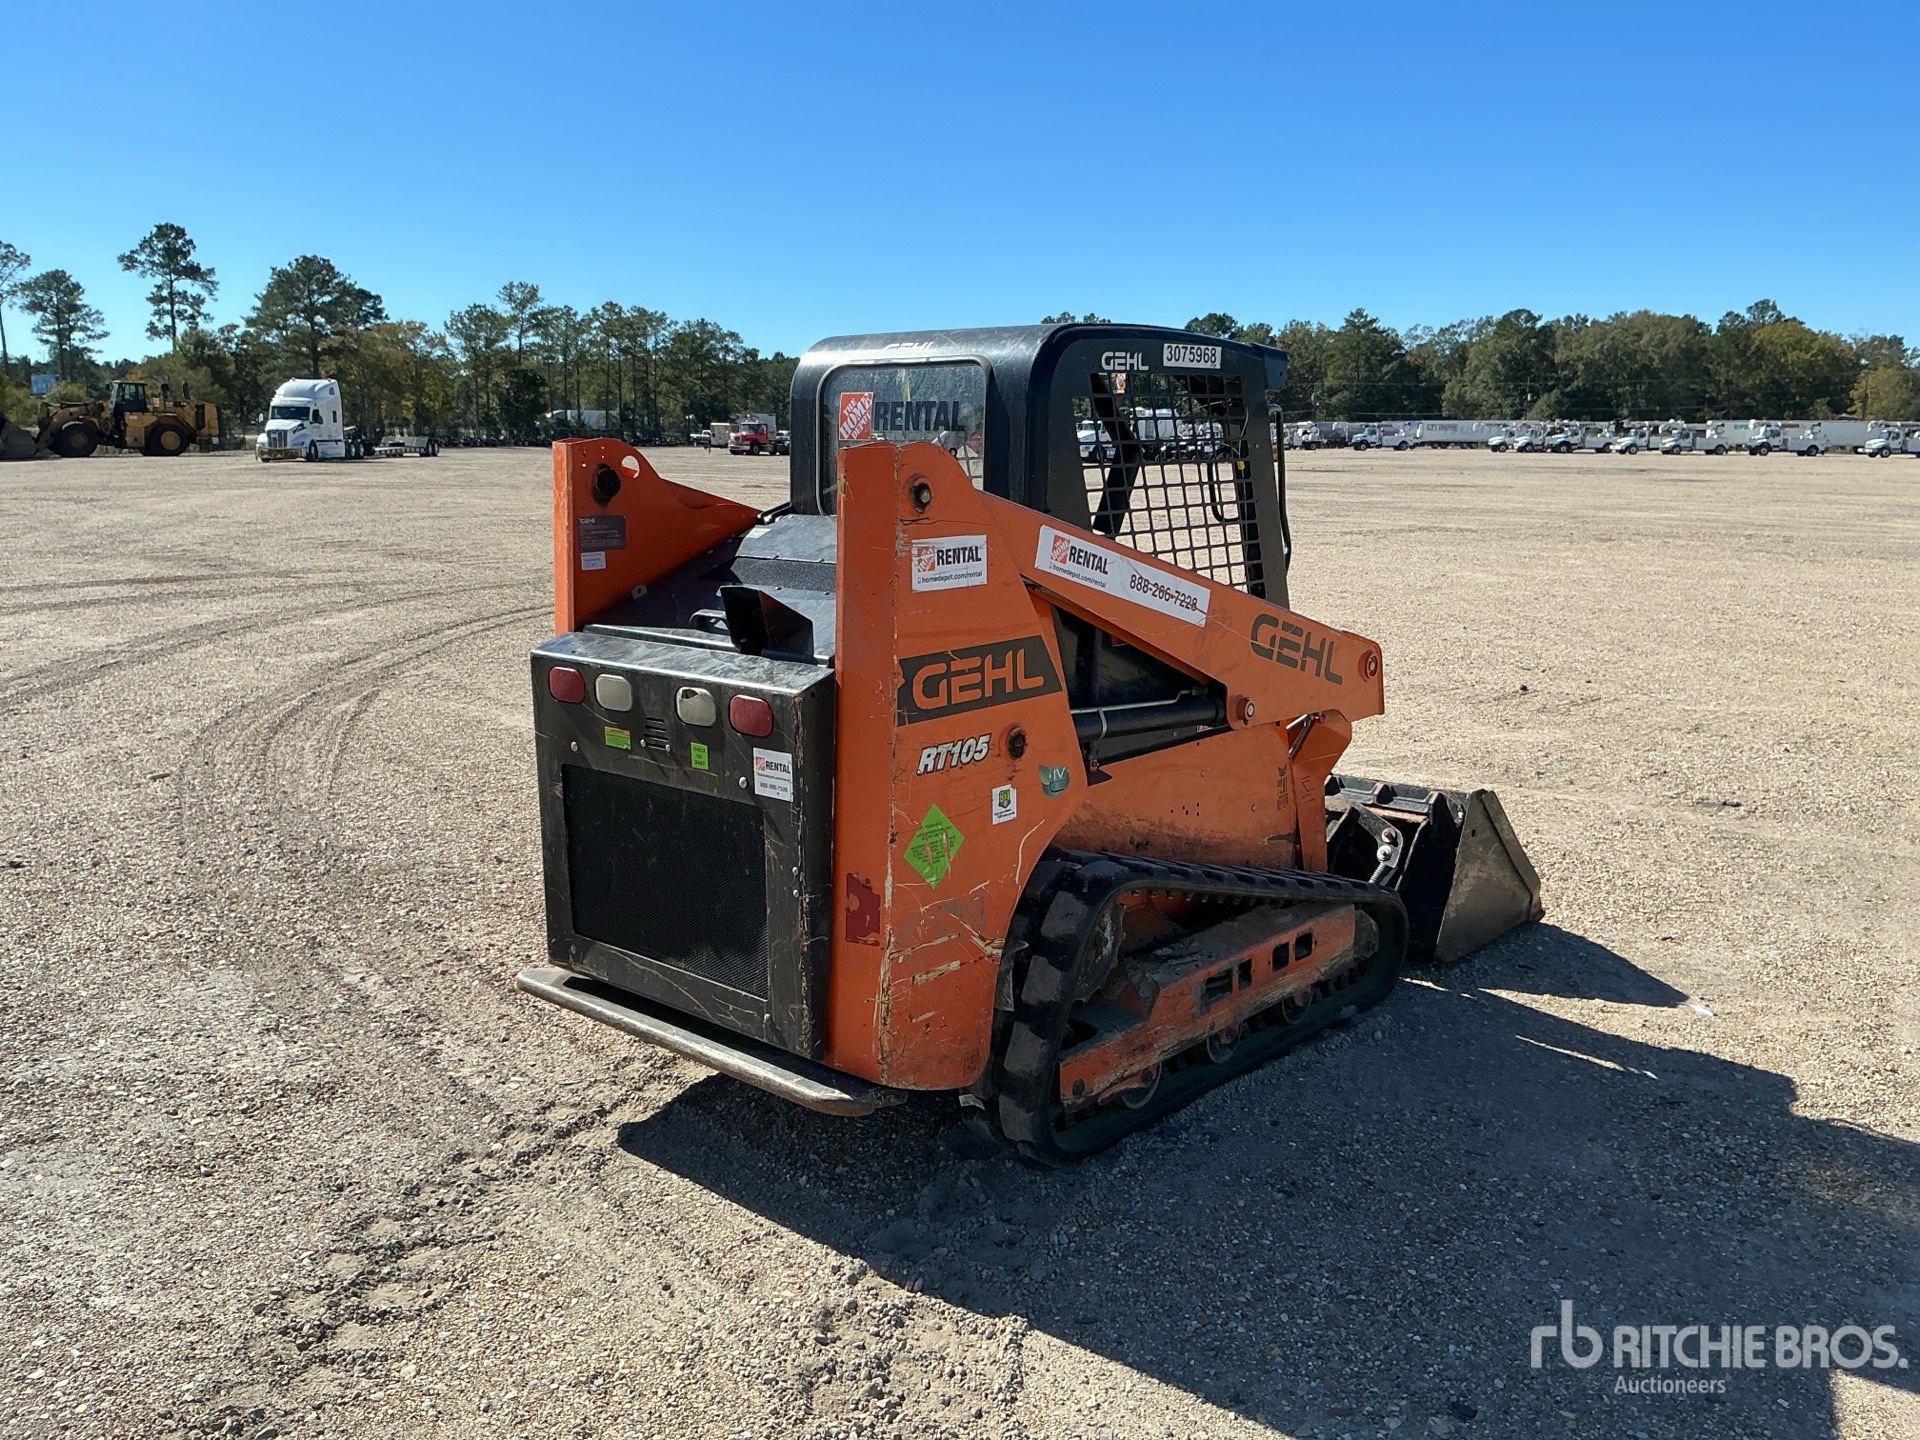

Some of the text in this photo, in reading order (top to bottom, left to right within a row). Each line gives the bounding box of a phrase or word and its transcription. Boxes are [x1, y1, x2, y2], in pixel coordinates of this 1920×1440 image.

[1101, 351, 1149, 371] GEHL
[1166, 344, 1217, 364] 3075968
[839, 392, 873, 440] HOME
[842, 398, 857, 417] THE
[873, 400, 965, 431] RENTAL
[936, 545, 982, 567] RENTAL
[1068, 545, 1109, 575] RENTAL
[921, 570, 983, 584] homedepot.com/rental
[1052, 563, 1107, 588] homedepot.com/rental
[1129, 574, 1198, 612] 888-266-7228
[1250, 613, 1344, 686] GEHL
[912, 648, 1045, 710] GEHL
[765, 760, 791, 774] RENTAL
[916, 733, 991, 775] RT105
